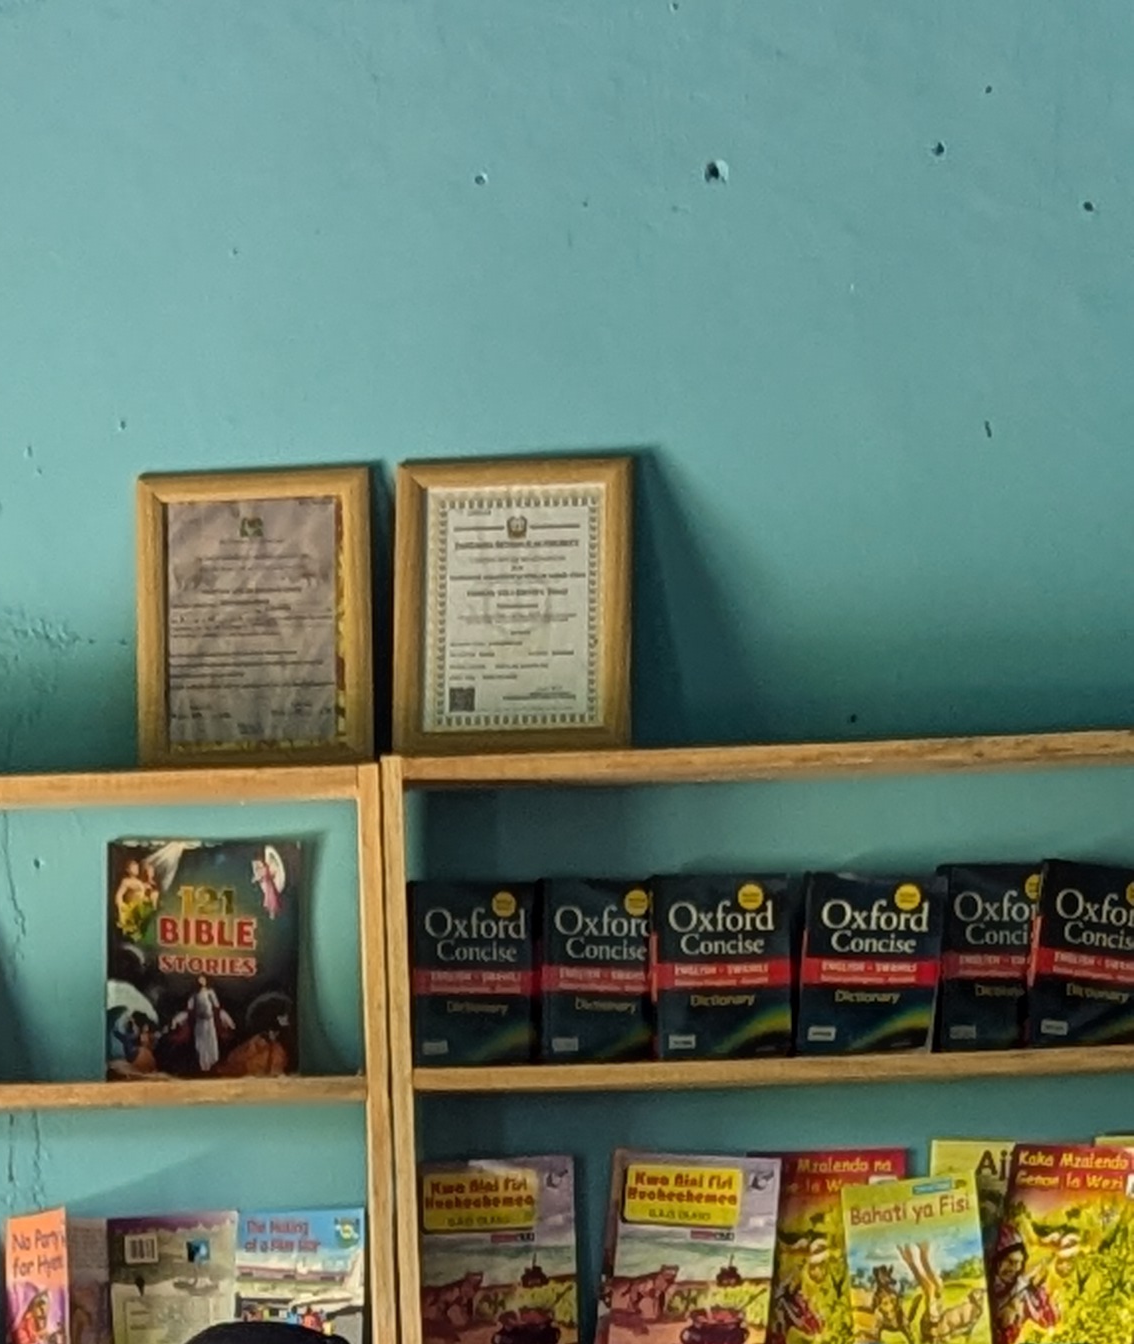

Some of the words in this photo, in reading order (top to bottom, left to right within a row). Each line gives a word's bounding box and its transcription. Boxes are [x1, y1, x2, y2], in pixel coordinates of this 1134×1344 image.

[178, 885, 234, 916] 121
[954, 890, 1037, 924] Oxfo
[1056, 888, 1134, 925] Oxfor
[424, 907, 527, 941] Oxford
[669, 900, 776, 934] Oxford
[821, 899, 930, 934] Oxford
[158, 916, 257, 949] BIBLE
[680, 932, 766, 957] Concise
[830, 930, 917, 954] Concise
[966, 922, 1028, 946] Conci
[1064, 921, 1134, 951] Concis
[436, 938, 518, 964] Concise
[566, 935, 649, 963] Concise
[158, 954, 257, 977] STORIES
[796, 1157, 869, 1174] Mzalendo
[873, 1160, 893, 1173] na
[1018, 1151, 1055, 1168] Kaka
[1059, 1153, 1129, 1171] Mzalendo
[633, 1171, 670, 1189] Kwa
[849, 1205, 908, 1227] Bahati
[914, 1204, 935, 1226] ya
[938, 1194, 971, 1215] Fisi
[12, 1232, 31, 1249] No
[12, 1253, 34, 1279] for
